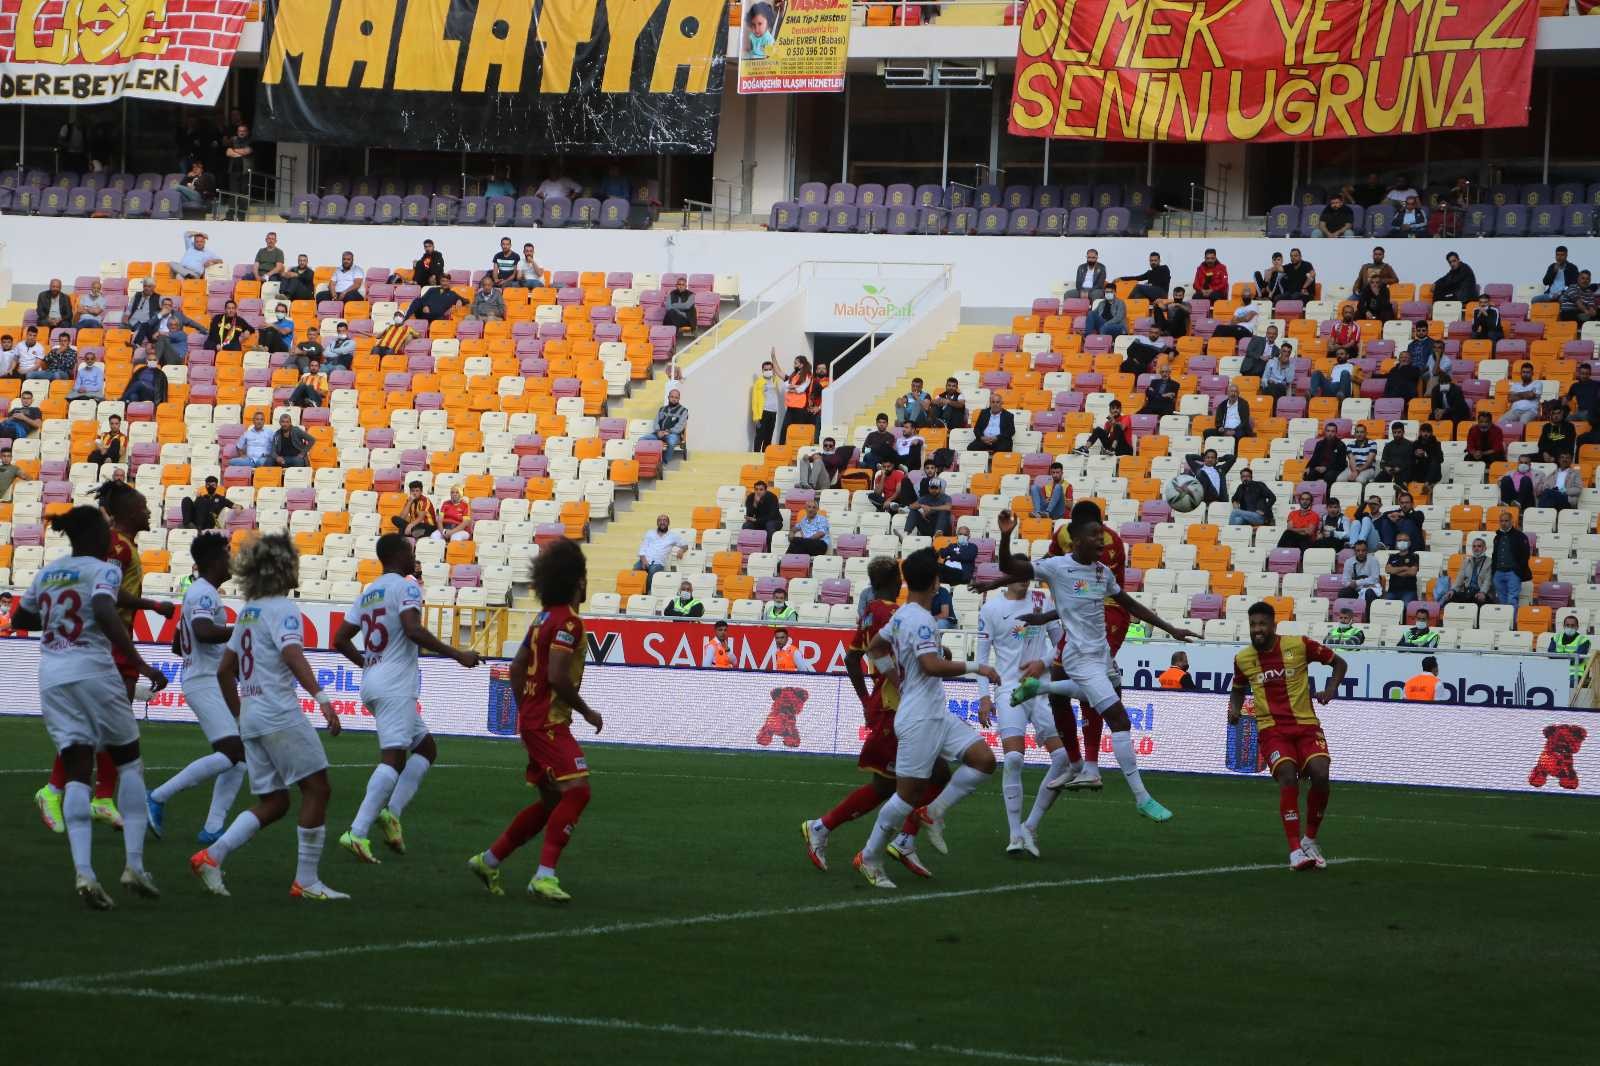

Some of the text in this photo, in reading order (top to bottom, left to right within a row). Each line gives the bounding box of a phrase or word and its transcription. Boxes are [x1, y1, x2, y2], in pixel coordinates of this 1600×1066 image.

[796, 36, 818, 45] EVREN
[805, 46, 818, 56] 396
[820, 46, 828, 56] 20
[0, 64, 180, 99] DEREBEYLERİ
[1012, 52, 1486, 142] SENİN UĞRUNA
[38, 589, 83, 644] 23
[240, 628, 254, 681] 8
